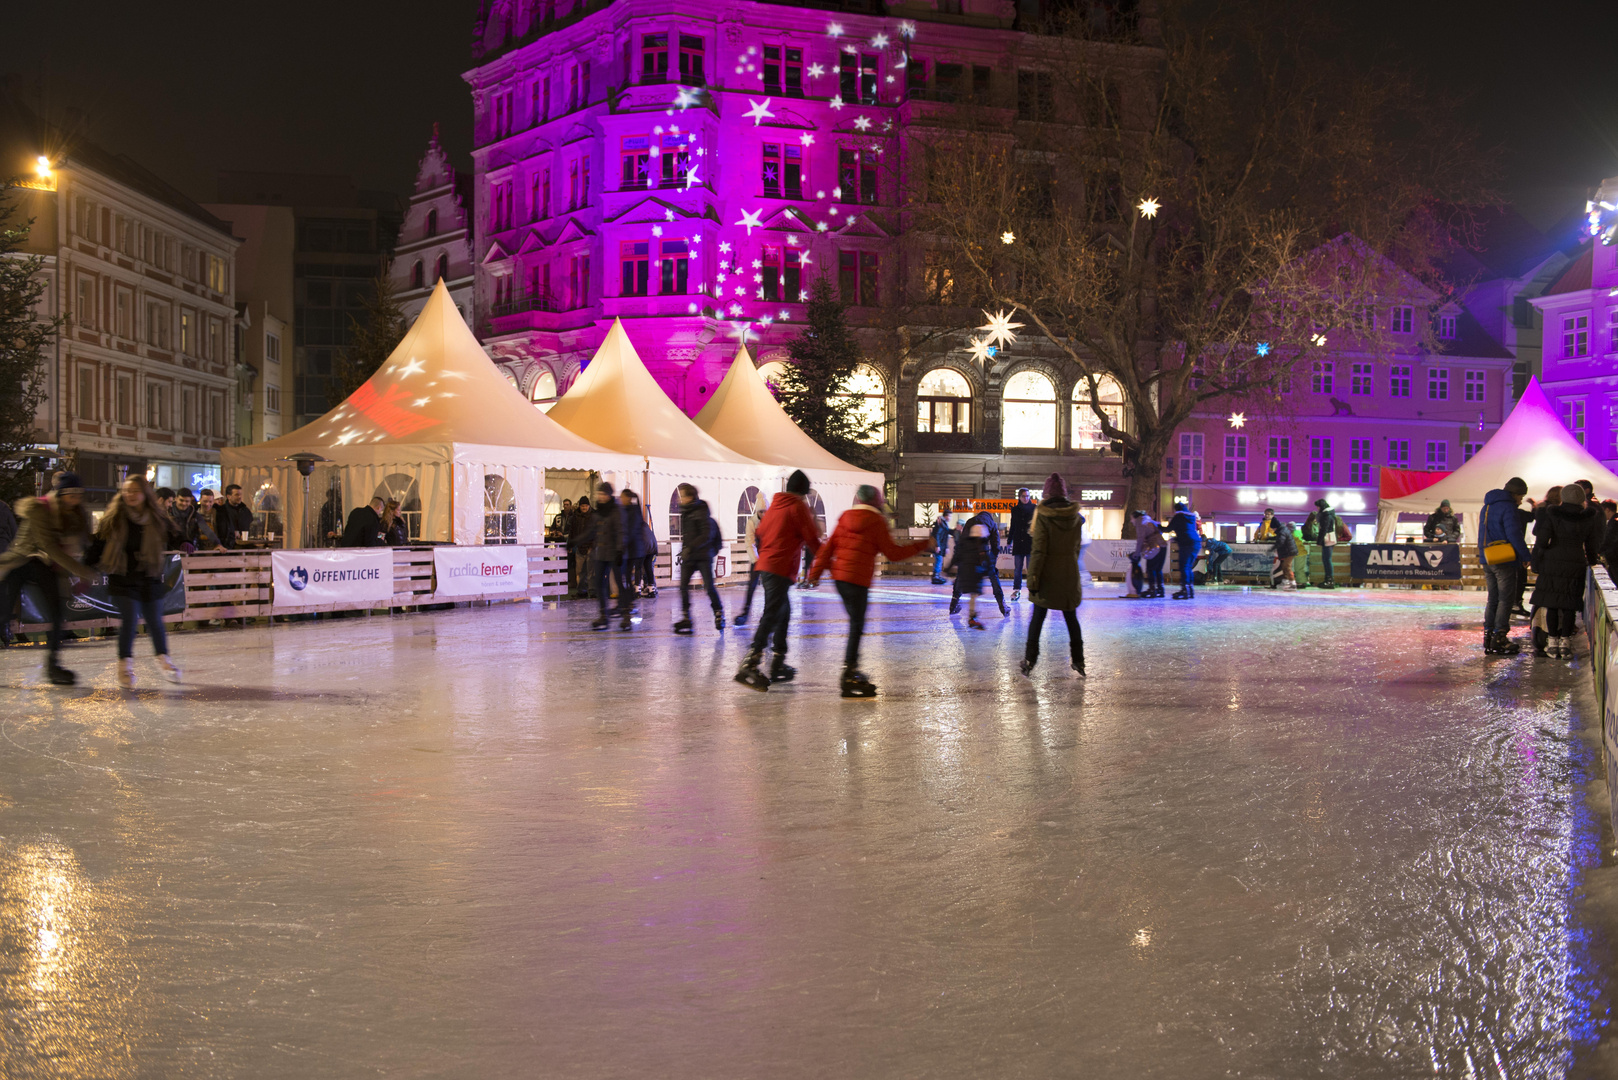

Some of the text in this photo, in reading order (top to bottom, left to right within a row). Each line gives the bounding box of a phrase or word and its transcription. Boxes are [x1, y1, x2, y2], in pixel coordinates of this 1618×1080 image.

[1081, 490, 1113, 501] ESPRIT
[1366, 550, 1421, 566] ALBA
[312, 569, 380, 583] ÖFFENTLICHE
[449, 562, 514, 577] radio ferner
